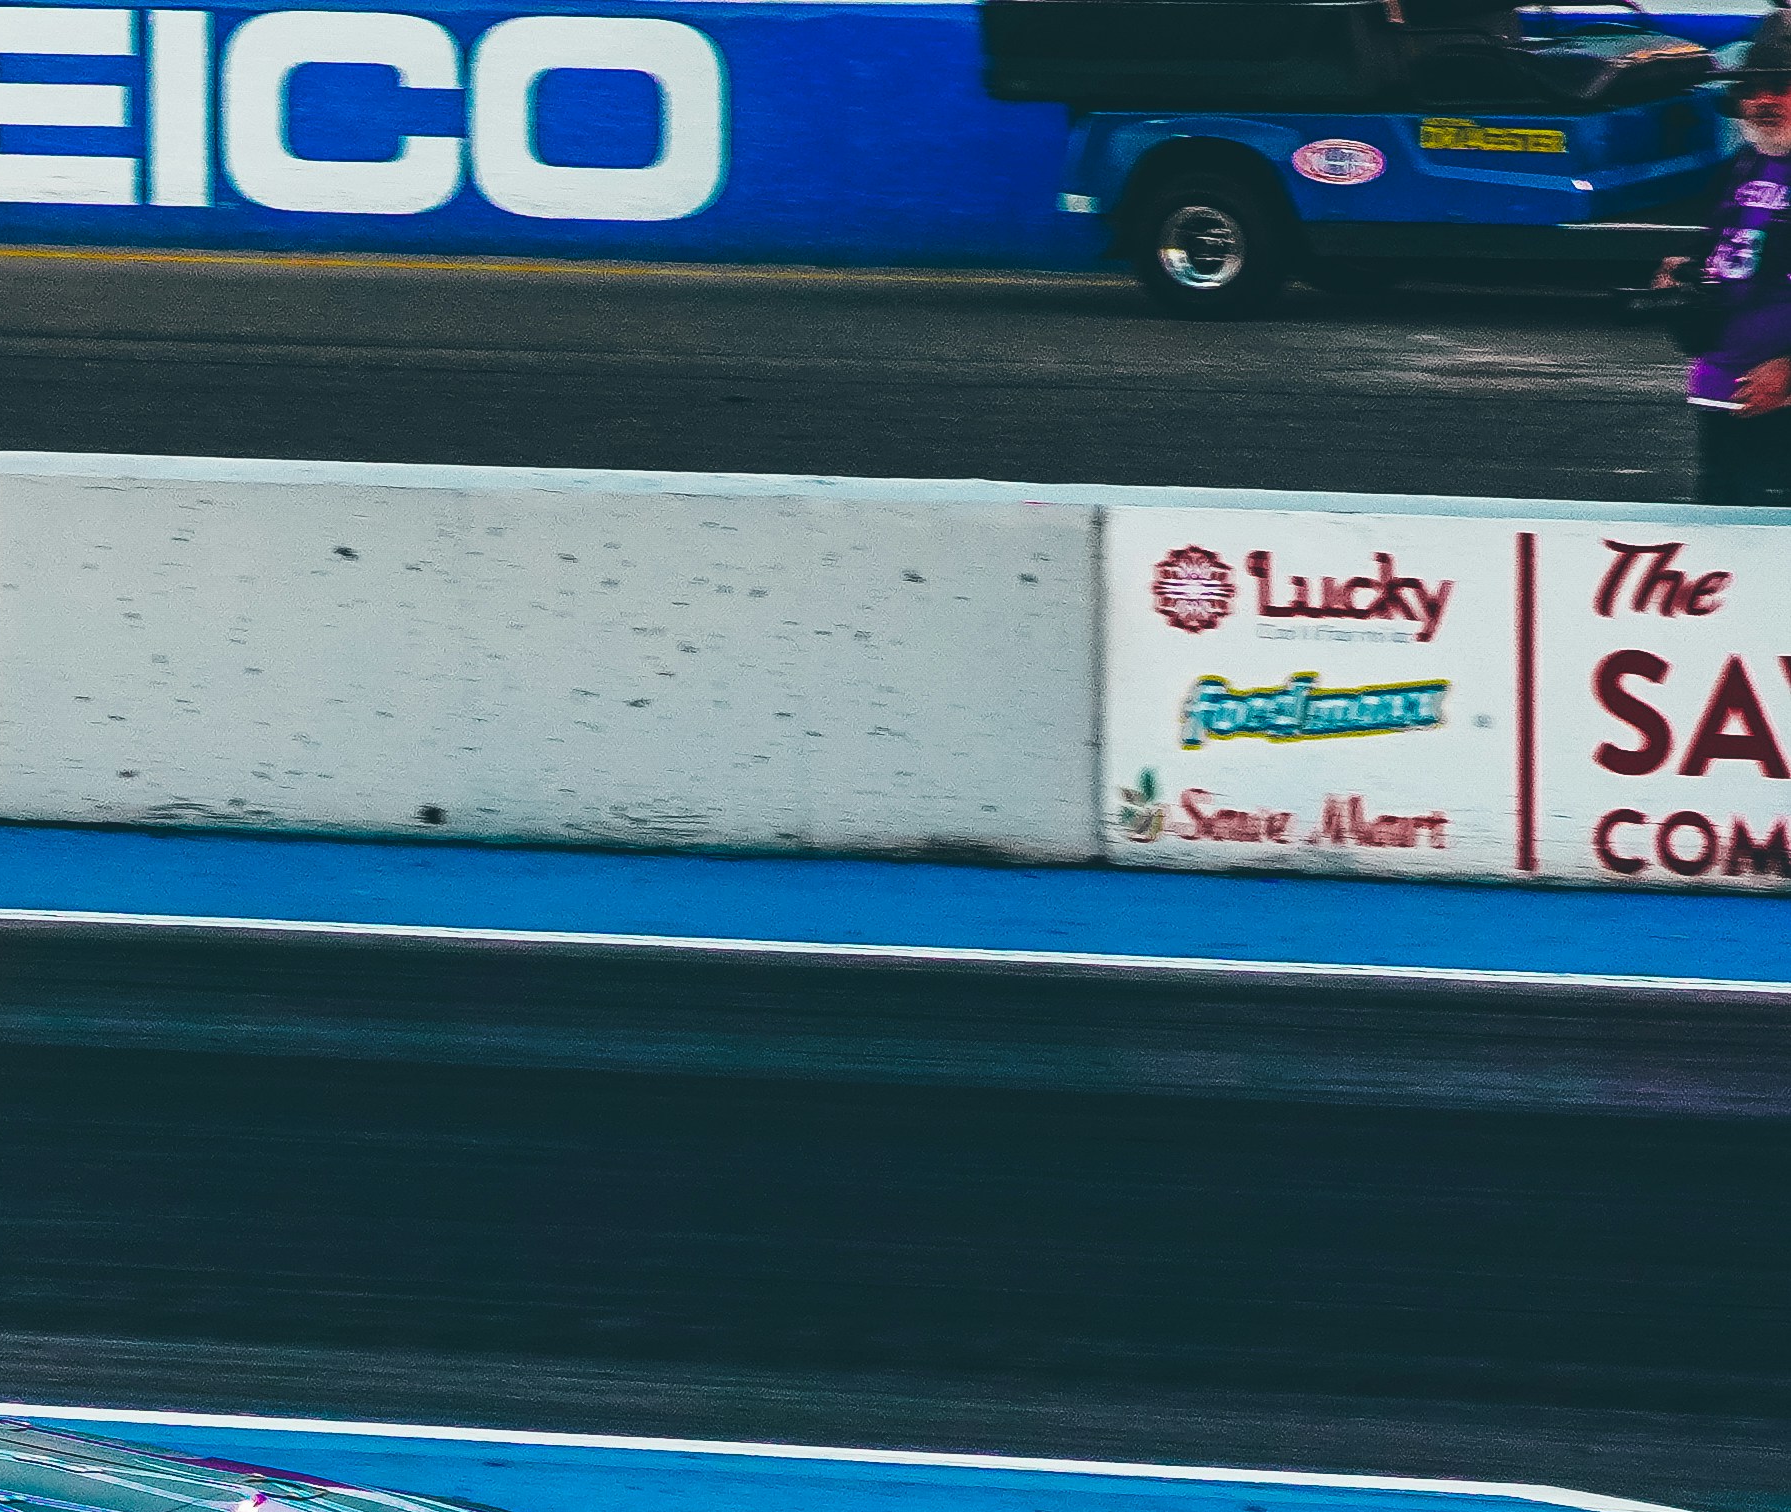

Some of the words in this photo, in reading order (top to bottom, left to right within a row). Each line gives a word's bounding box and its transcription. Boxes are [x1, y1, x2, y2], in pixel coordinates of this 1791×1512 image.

[1247, 549, 1455, 643] Lucky
[1593, 538, 1735, 618] The
[1591, 648, 1791, 779] SA
